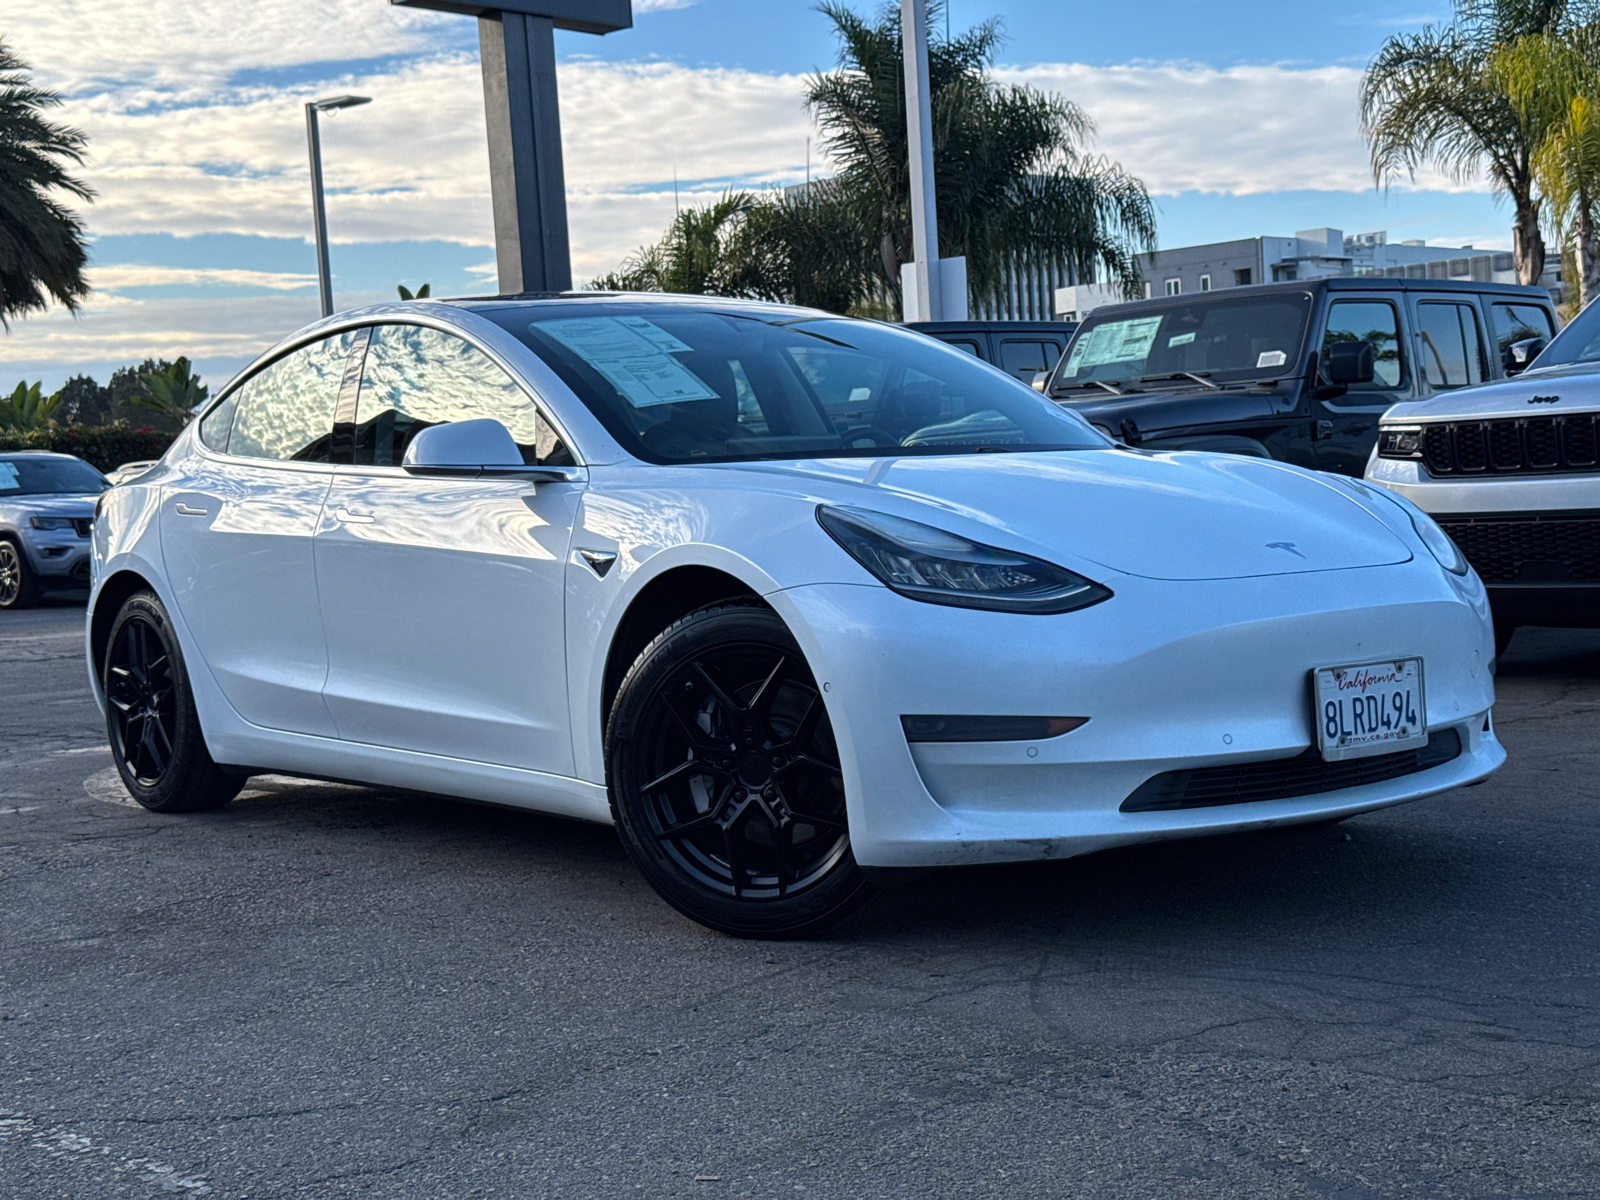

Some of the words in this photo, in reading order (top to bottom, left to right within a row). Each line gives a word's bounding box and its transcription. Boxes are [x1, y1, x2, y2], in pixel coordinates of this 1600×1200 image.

[1527, 395, 1560, 404] Jeep
[1339, 669, 1402, 693] California
[1325, 690, 1417, 738] 8LRD494
